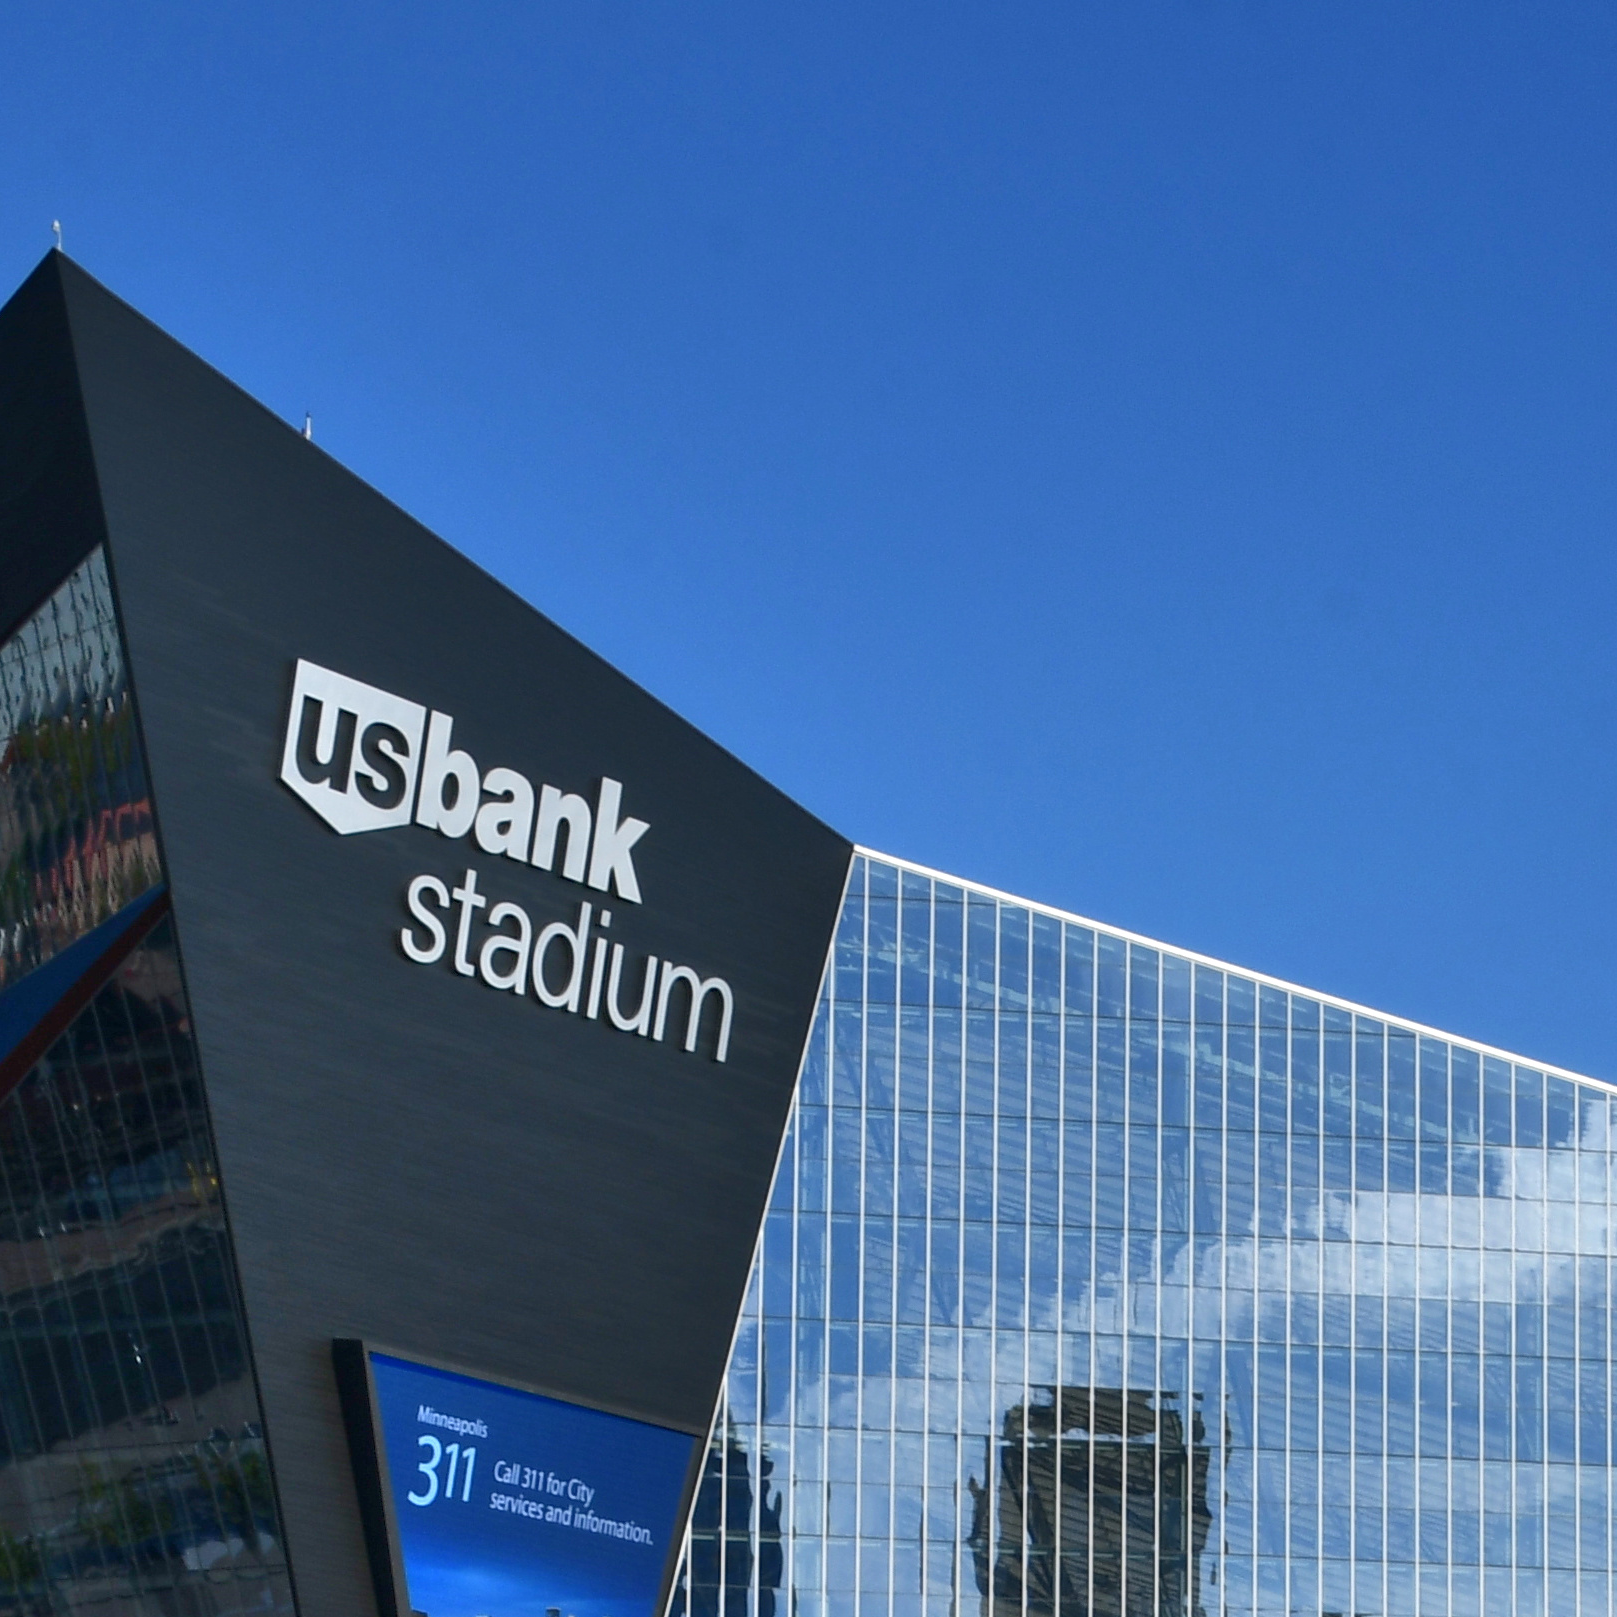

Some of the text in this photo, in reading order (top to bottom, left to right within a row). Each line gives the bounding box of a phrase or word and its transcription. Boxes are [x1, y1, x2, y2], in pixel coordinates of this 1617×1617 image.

[400, 868, 734, 1064] stadium
[417, 1404, 488, 1438] Minneapolis
[407, 1434, 477, 1507] 311
[494, 1460, 595, 1507] Call 311 for City
[489, 1492, 655, 1546] services and information.
